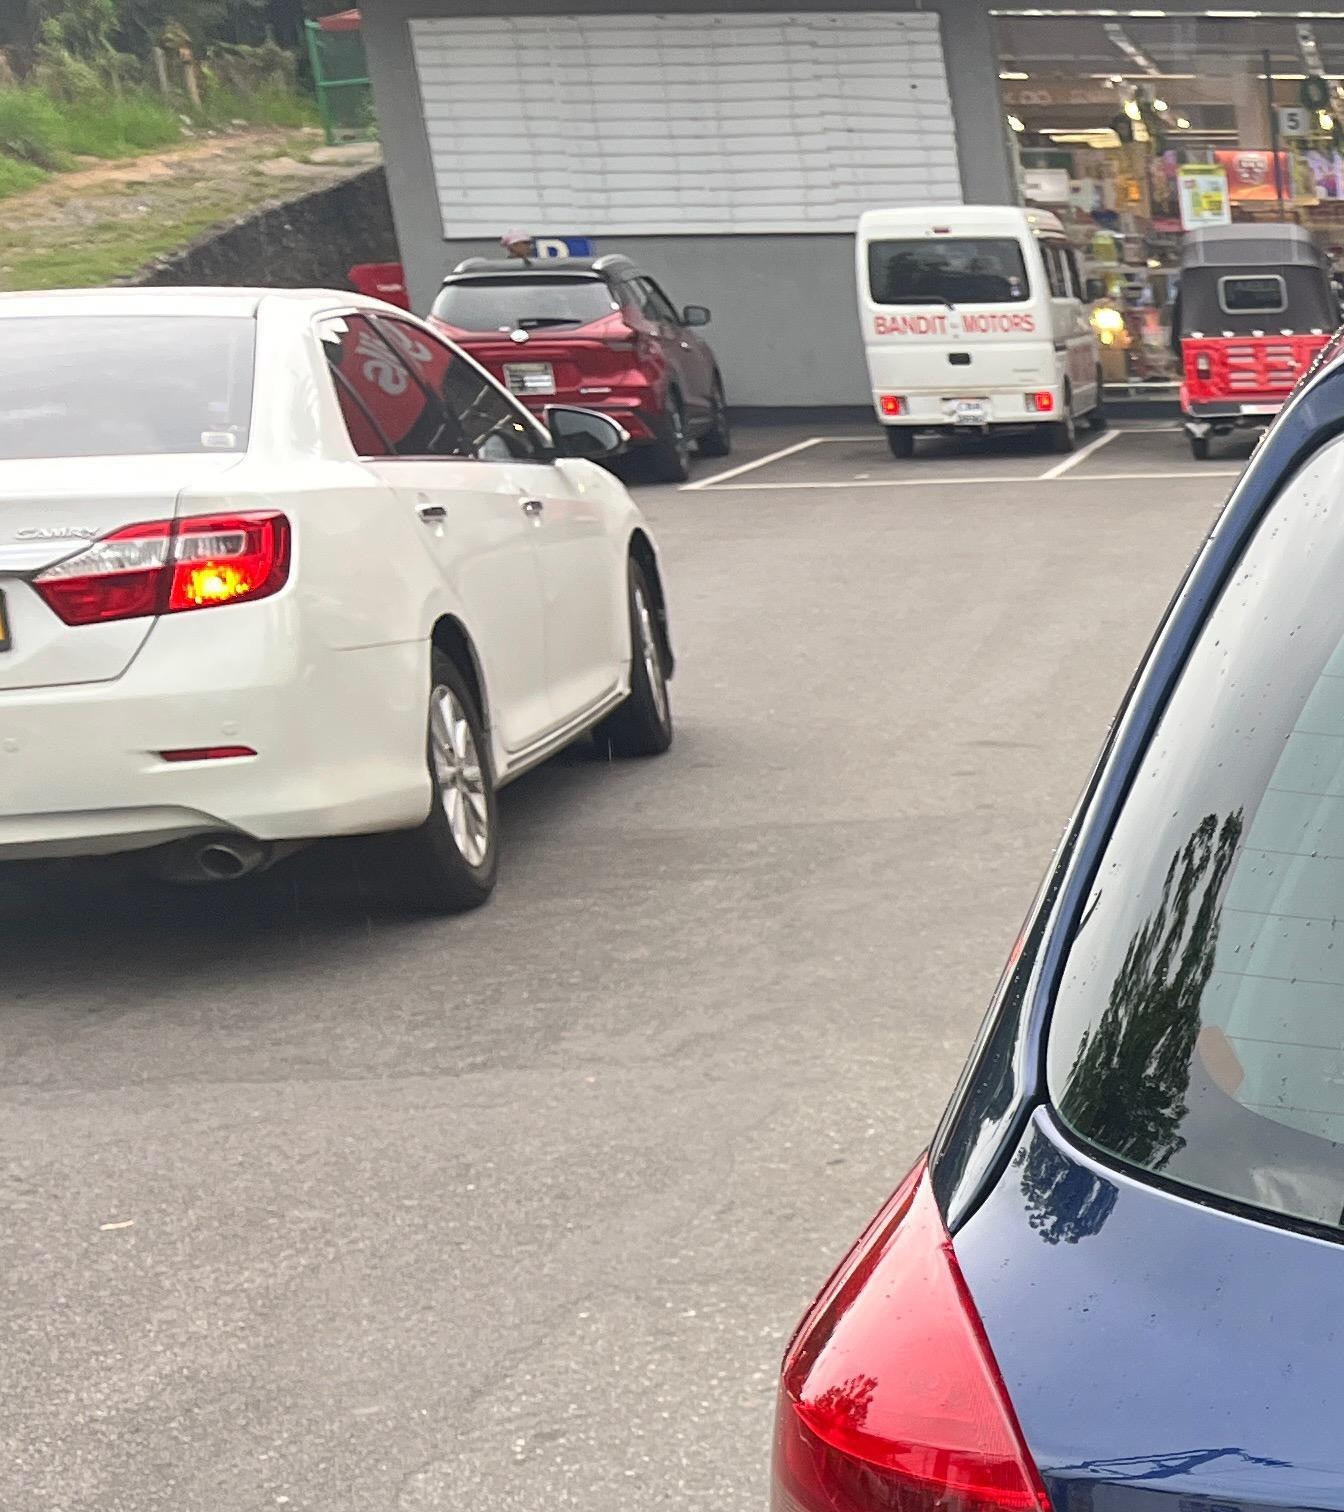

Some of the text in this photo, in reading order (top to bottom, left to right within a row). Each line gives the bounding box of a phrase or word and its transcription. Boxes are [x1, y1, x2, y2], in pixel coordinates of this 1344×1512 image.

[1286, 113, 1299, 130] 5
[874, 314, 1036, 335] BANDIT MOTORS
[15, 527, 101, 541] CAMRY
